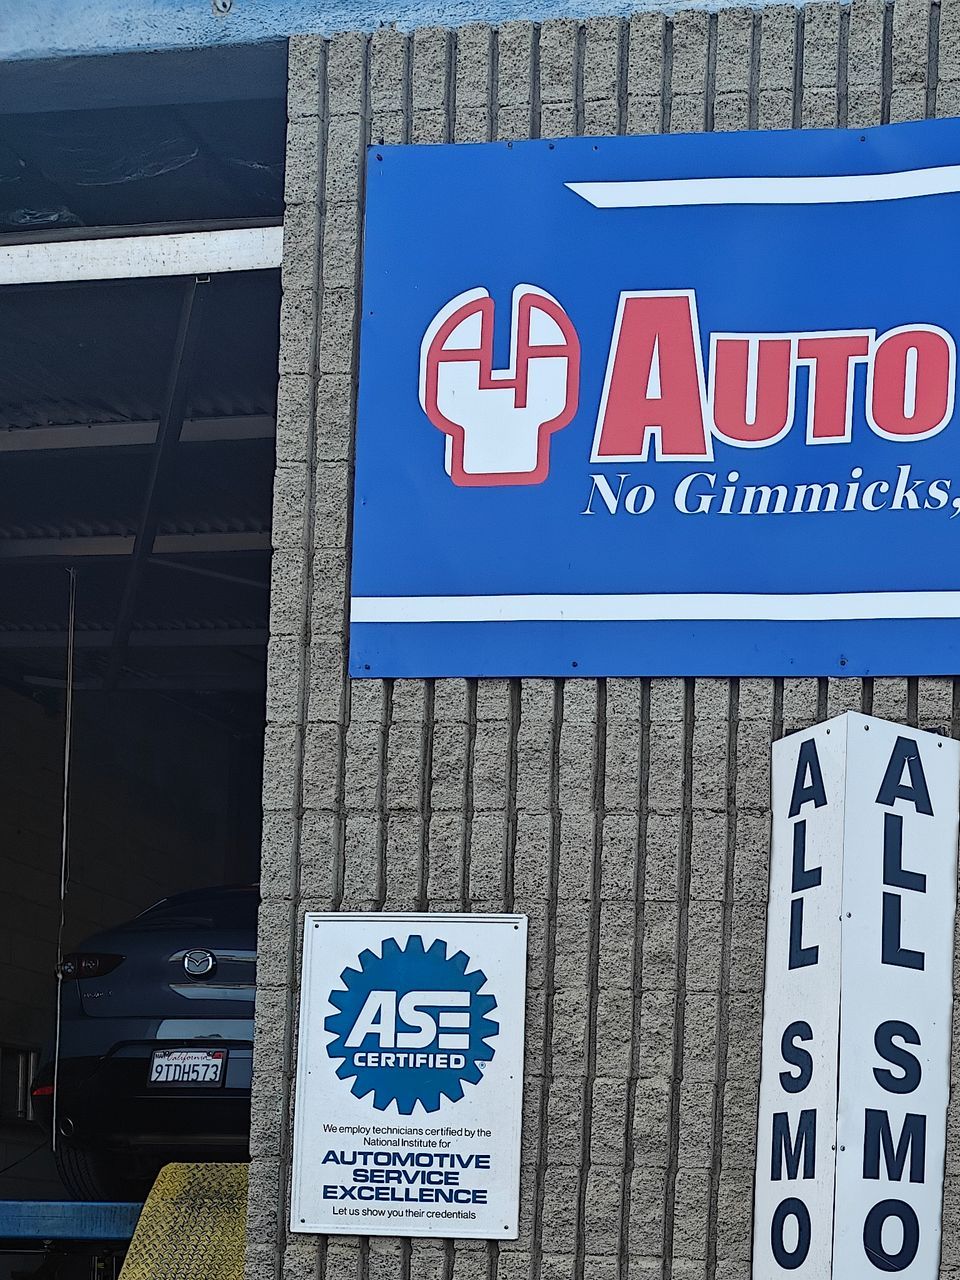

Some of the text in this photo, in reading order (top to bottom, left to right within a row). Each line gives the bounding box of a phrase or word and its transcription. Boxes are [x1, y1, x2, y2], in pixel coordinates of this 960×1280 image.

[590, 289, 956, 462] AUTO
[580, 473, 656, 516] No
[788, 737, 828, 970] ALL
[875, 735, 934, 971] ALL
[343, 990, 471, 1050] ASE
[353, 1052, 467, 1069] CERTIFIED
[153, 1063, 220, 1082] 9TDH573
[322, 1123, 492, 1138] We employ technicians certified by the
[363, 1137, 452, 1149] National Institute for
[321, 1149, 491, 1169] AUTOMOTIVE
[352, 1168, 460, 1186] SERVICE
[322, 1184, 489, 1205] EXCELLENCE
[332, 1206, 477, 1220] Let us show you their credentials
